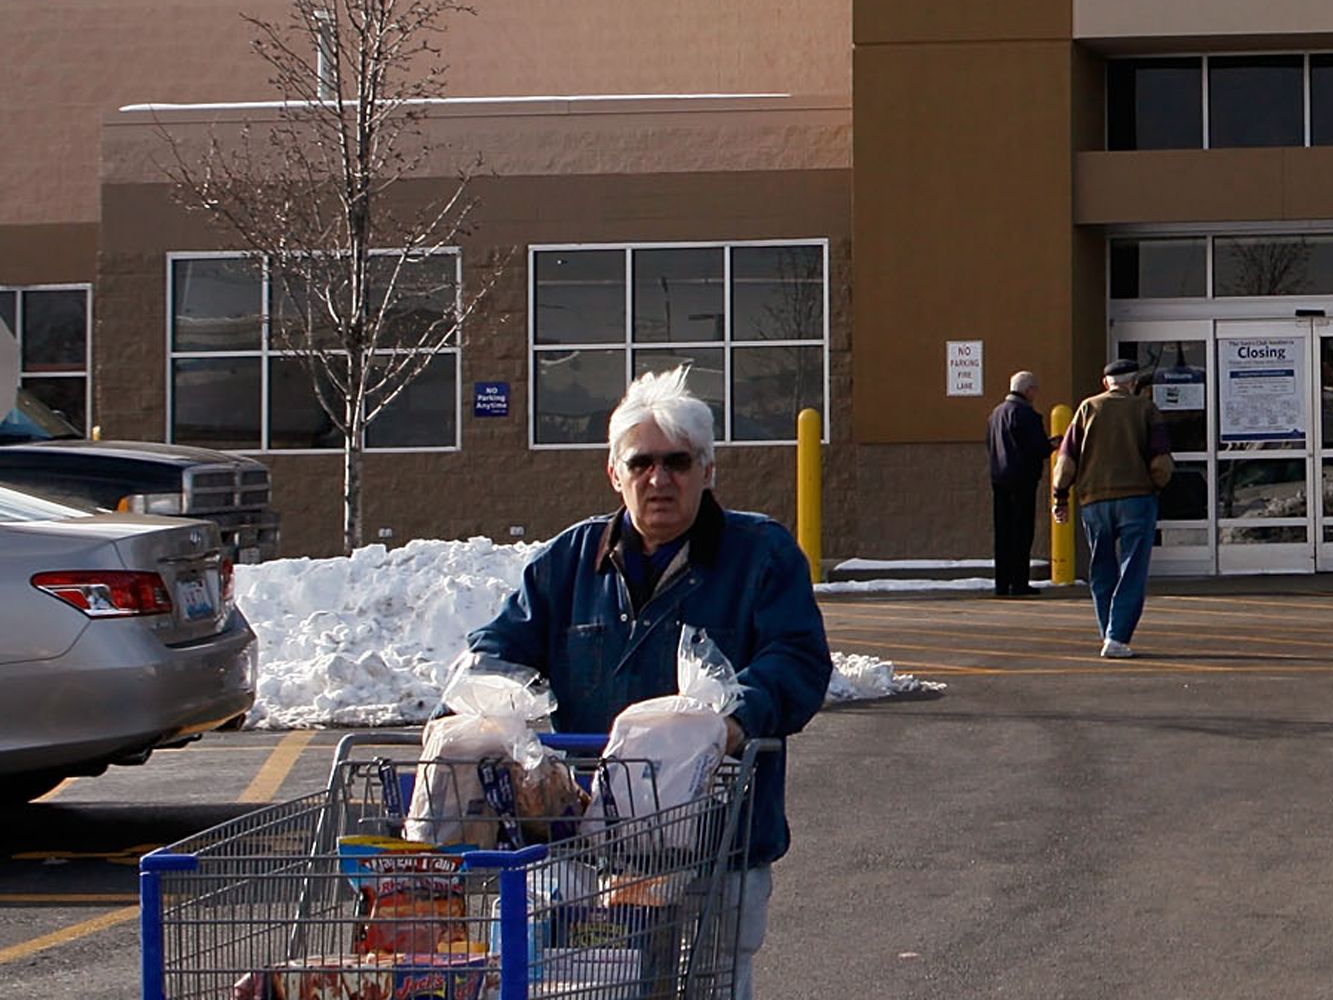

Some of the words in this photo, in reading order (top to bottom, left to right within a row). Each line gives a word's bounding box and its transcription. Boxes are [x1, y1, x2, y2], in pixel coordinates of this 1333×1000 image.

[958, 346, 971, 356] NO
[1238, 346, 1286, 360] Closing
[950, 359, 980, 367] PARKING
[477, 394, 506, 402] Parking
[476, 402, 507, 410] Anytime
